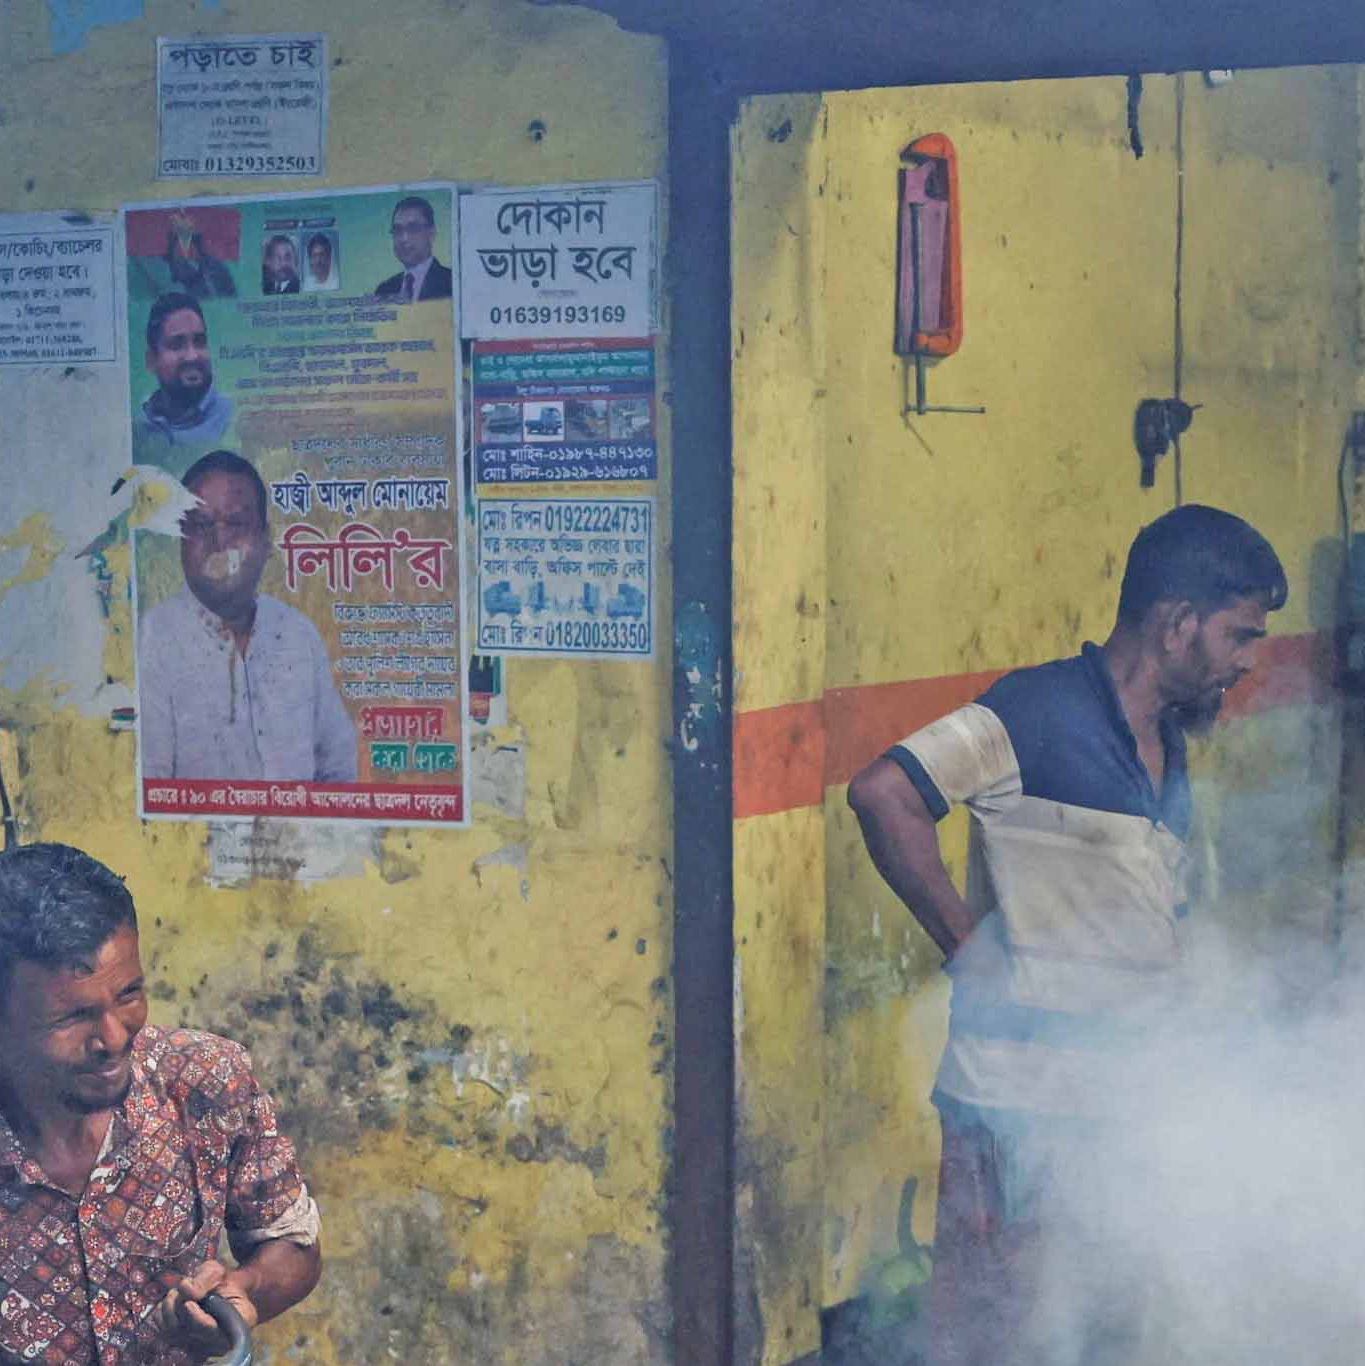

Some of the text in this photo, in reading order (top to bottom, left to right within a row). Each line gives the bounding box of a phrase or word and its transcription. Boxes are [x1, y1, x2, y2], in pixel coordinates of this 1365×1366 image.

[170, 40, 316, 72] পড়াতে চাই
[205, 156, 315, 172] 01329352503
[497, 197, 607, 235] দোকান
[476, 242, 638, 288] ভাড়া হবে
[490, 305, 626, 325] 01639193169
[316, 480, 366, 515] আব্দুল
[373, 479, 449, 509] মোনায়েম
[545, 506, 647, 533] 01922224731
[546, 622, 647, 649] 01820033350
